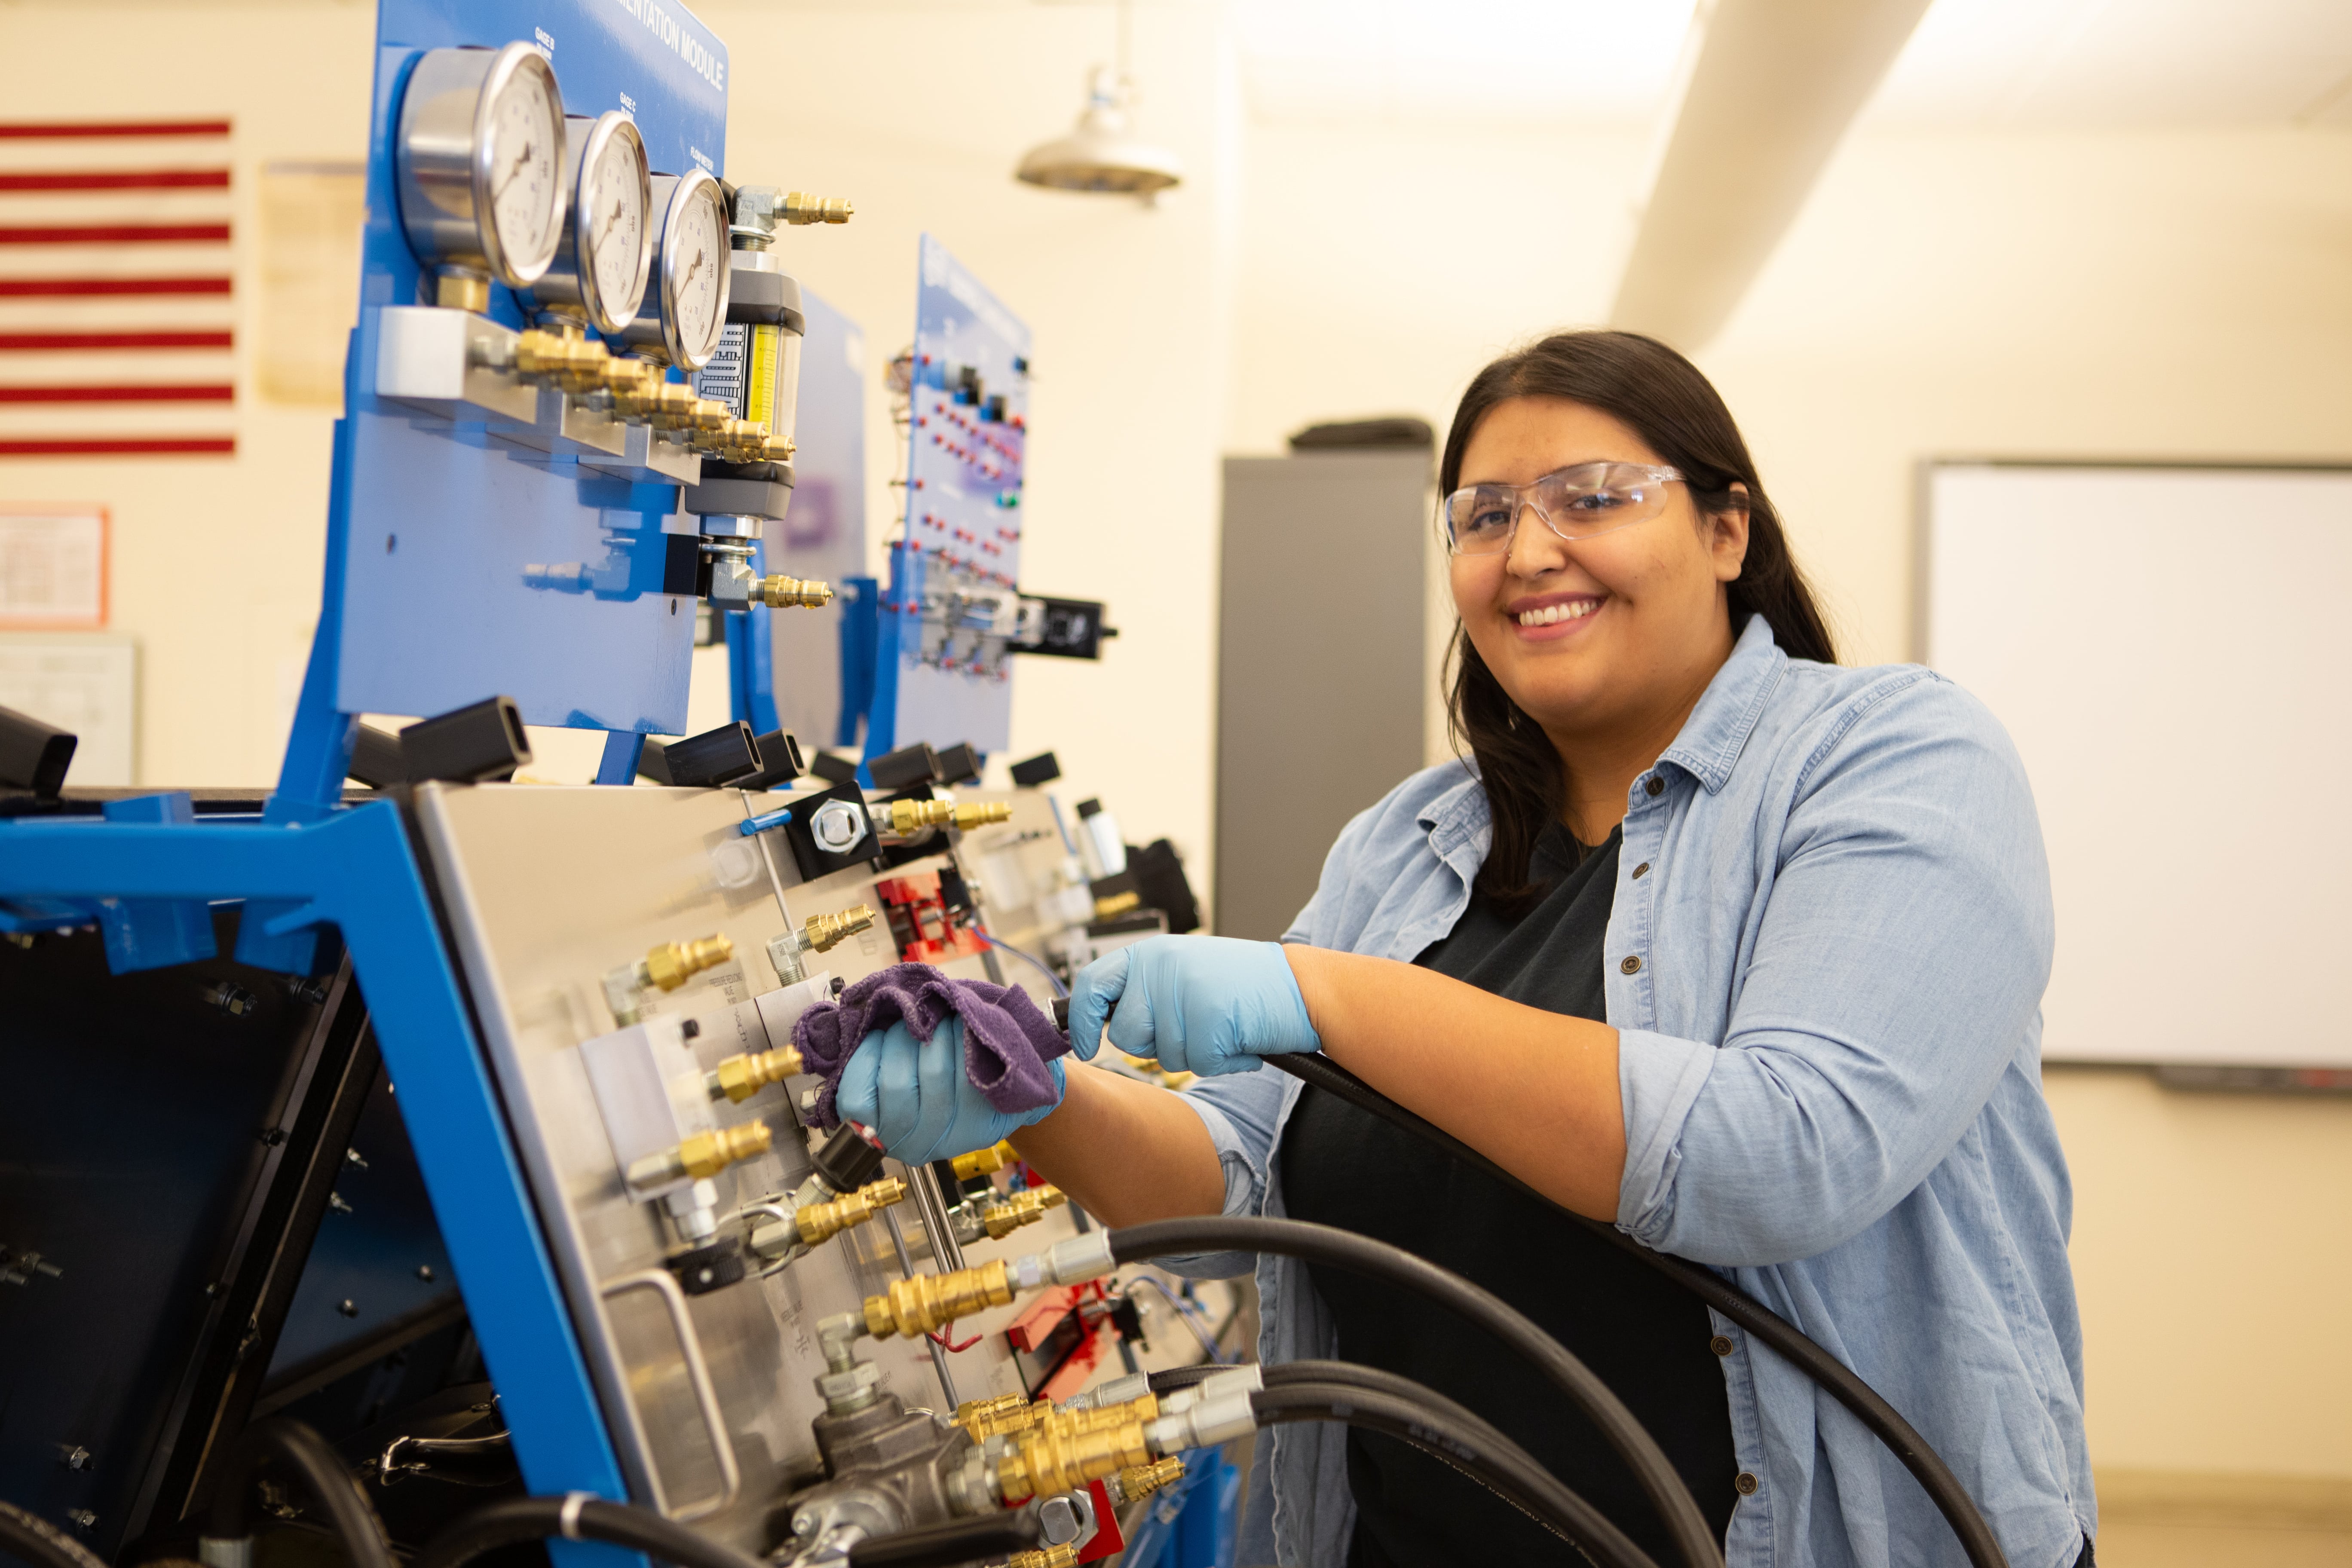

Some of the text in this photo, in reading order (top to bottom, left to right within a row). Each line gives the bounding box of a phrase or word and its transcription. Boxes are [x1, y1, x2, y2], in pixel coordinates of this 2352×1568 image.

[535, 27, 554, 51] GAGE B
[681, 30, 724, 92] MODULE
[620, 92, 636, 112] GAGE C
[690, 146, 701, 163] FLOW
[701, 154, 713, 172] METER
